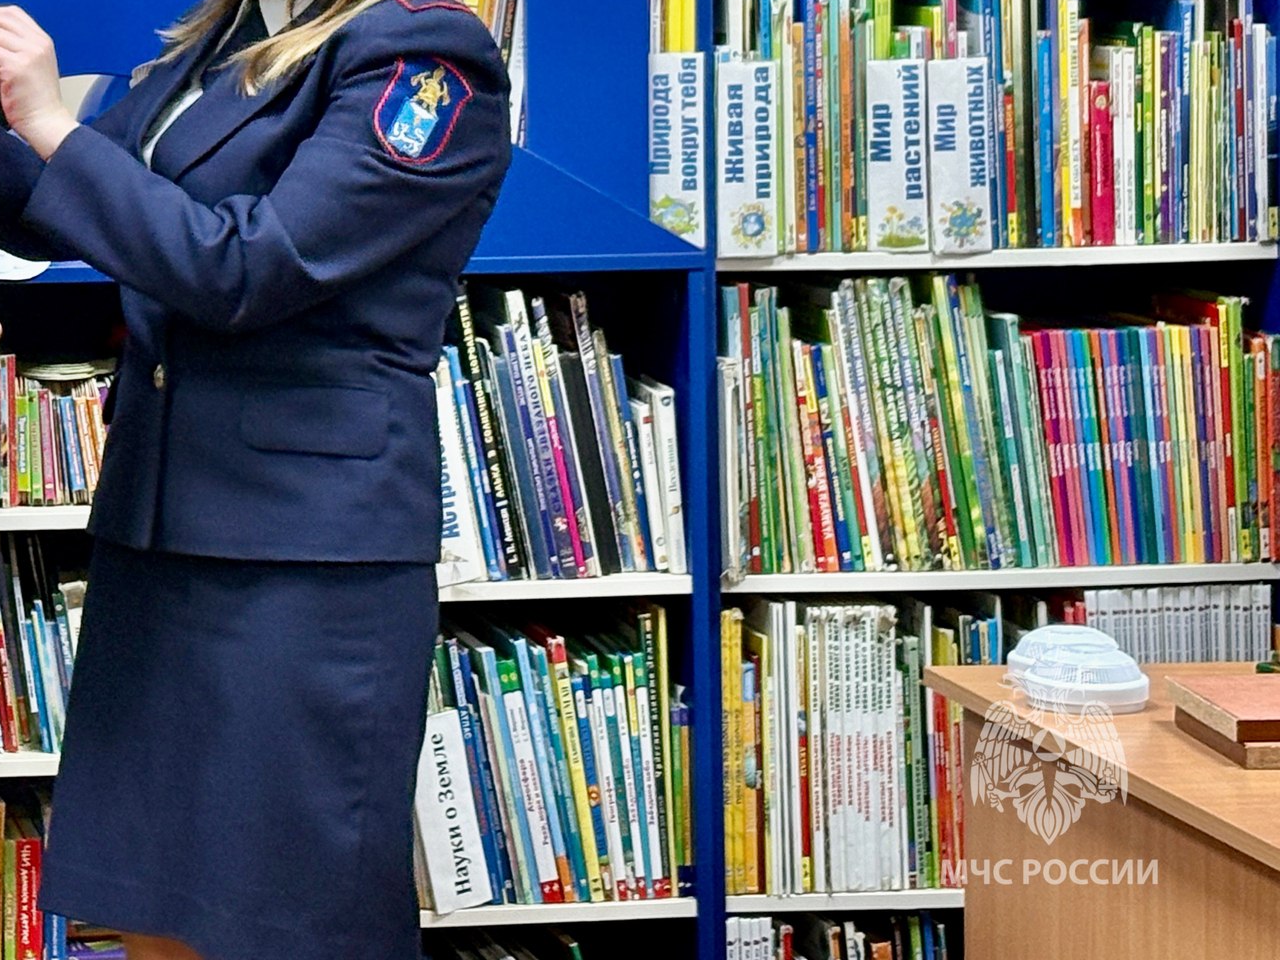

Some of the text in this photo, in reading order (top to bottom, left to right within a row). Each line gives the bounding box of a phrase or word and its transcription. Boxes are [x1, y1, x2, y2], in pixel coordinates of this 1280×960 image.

[650, 73, 672, 175] Природа
[679, 58, 699, 191] вокруг тебя
[724, 84, 744, 183] Живая
[753, 66, 772, 199] природа
[870, 103, 892, 162] Мир
[897, 64, 923, 200] растений
[934, 104, 957, 152] Мир
[518, 334, 533, 370] НЕБА
[474, 380, 494, 444] СОЛНЕЧНОМ
[490, 463, 506, 499] АЛЬКА
[428, 733, 473, 895] Науки о Земле
